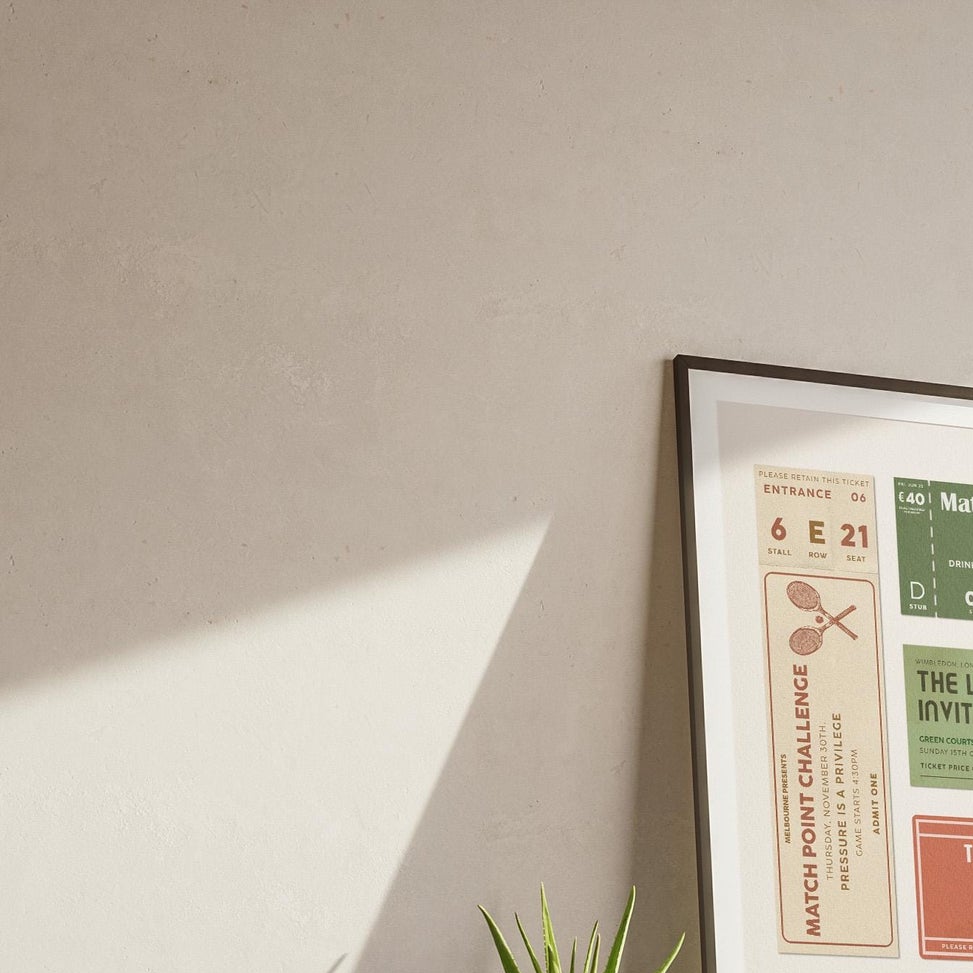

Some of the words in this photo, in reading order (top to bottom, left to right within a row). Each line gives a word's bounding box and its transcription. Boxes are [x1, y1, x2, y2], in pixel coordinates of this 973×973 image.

[759, 471, 788, 479] PLEASE
[791, 474, 819, 482] RETAIN
[822, 477, 839, 485] THIS
[842, 479, 869, 487] TICKET
[764, 484, 832, 499] ENTRANCE
[851, 492, 866, 502] 06
[898, 491, 926, 506] €40
[771, 517, 787, 541] 6
[809, 520, 826, 545] E
[841, 523, 869, 548] 21
[767, 548, 792, 556] STALL
[808, 551, 828, 559] ROW
[846, 555, 866, 563] SEAT
[910, 581, 925, 600] D
[909, 603, 927, 611] STUB
[917, 670, 959, 695] THE
[792, 664, 814, 788] CHALLENGE
[832, 713, 844, 784] PRIVILEGE
[919, 735, 945, 744] GREEN
[919, 747, 948, 756] SUNDAY
[780, 753, 789, 794] PRESENTS
[850, 749, 860, 785] 4:30PM
[920, 762, 946, 770] TICKET
[949, 764, 970, 772] PRICE
[820, 756, 832, 817] NOVEMBER
[836, 790, 846, 798] A
[870, 773, 878, 796] ONE
[837, 803, 847, 815] IS
[853, 788, 862, 824] STARTS
[871, 800, 881, 835] ADMIT
[783, 795, 791, 844] MELBOURNE
[799, 793, 817, 857] POINT
[855, 828, 863, 857] GAME
[838, 820, 850, 891] PRESSURE
[803, 864, 821, 937] MATCH
[942, 943, 967, 951] PLEASE
